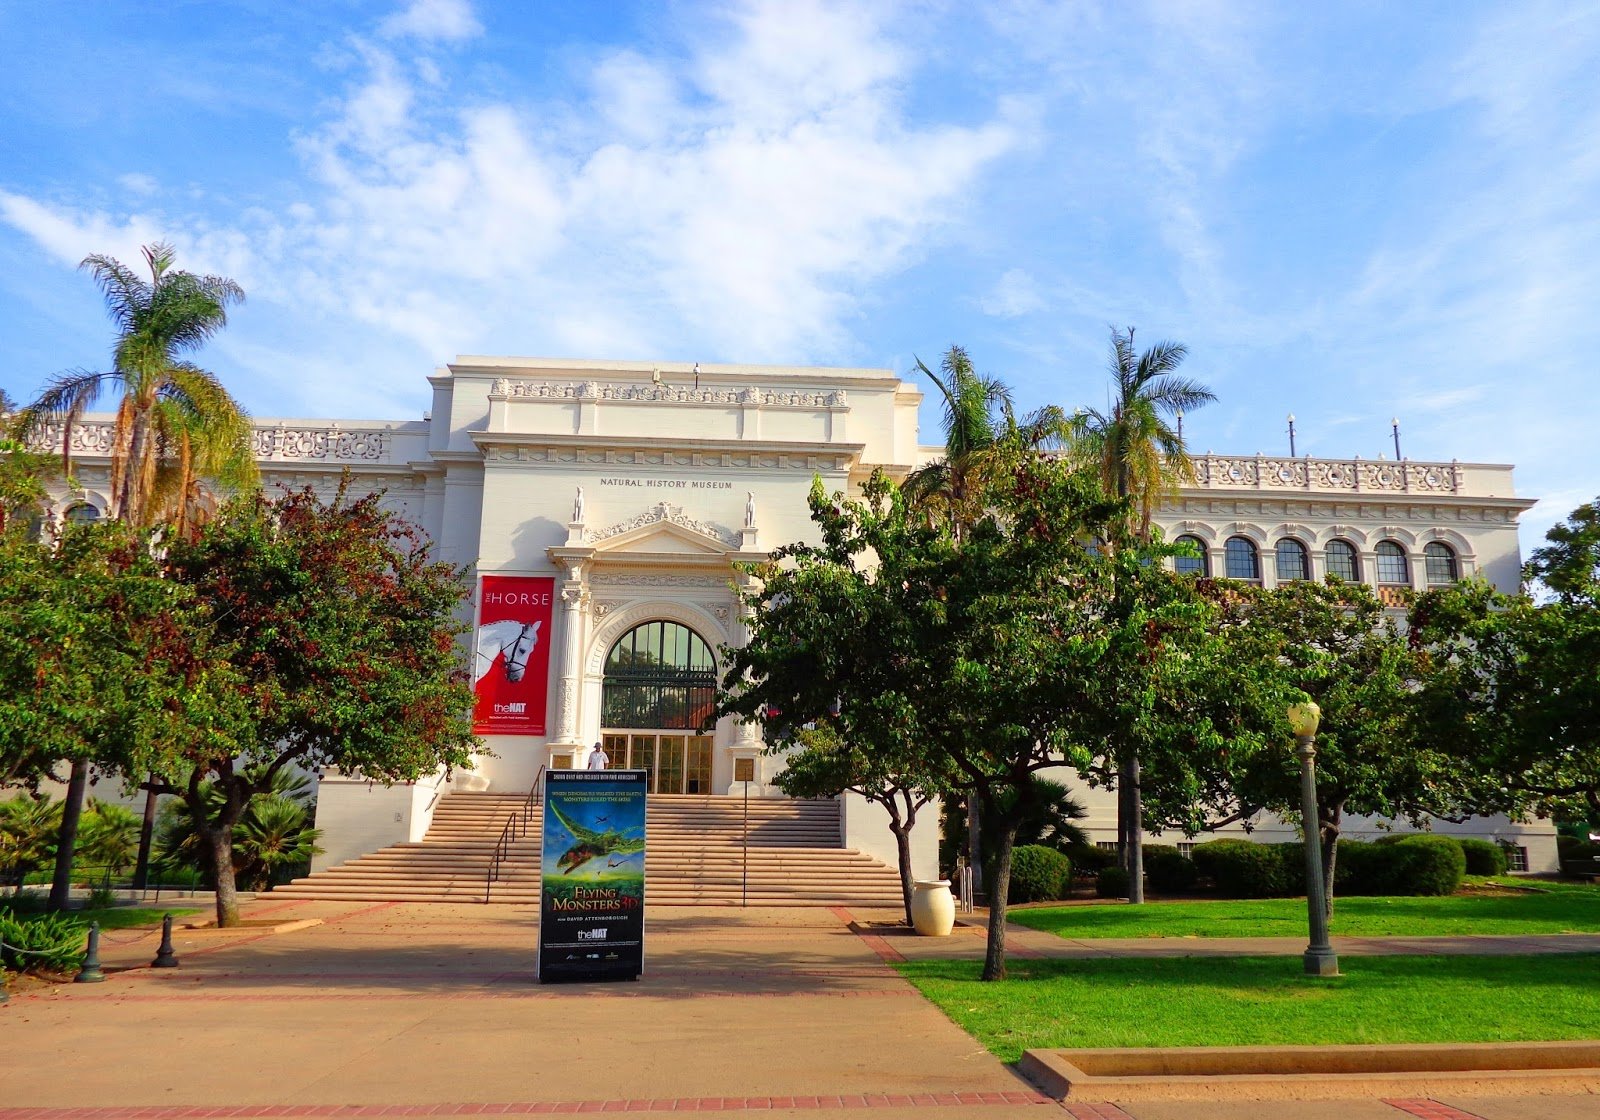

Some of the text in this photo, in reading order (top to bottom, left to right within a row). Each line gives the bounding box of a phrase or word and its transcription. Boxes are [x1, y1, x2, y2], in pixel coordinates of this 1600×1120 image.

[600, 478, 732, 489] NATURAL HISTORY MUSEUM
[491, 592, 549, 606] HORSE
[494, 702, 526, 713] theNAT
[575, 886, 616, 899] FLYING
[553, 897, 620, 911] MONSTERS
[577, 928, 608, 939] theNAT
